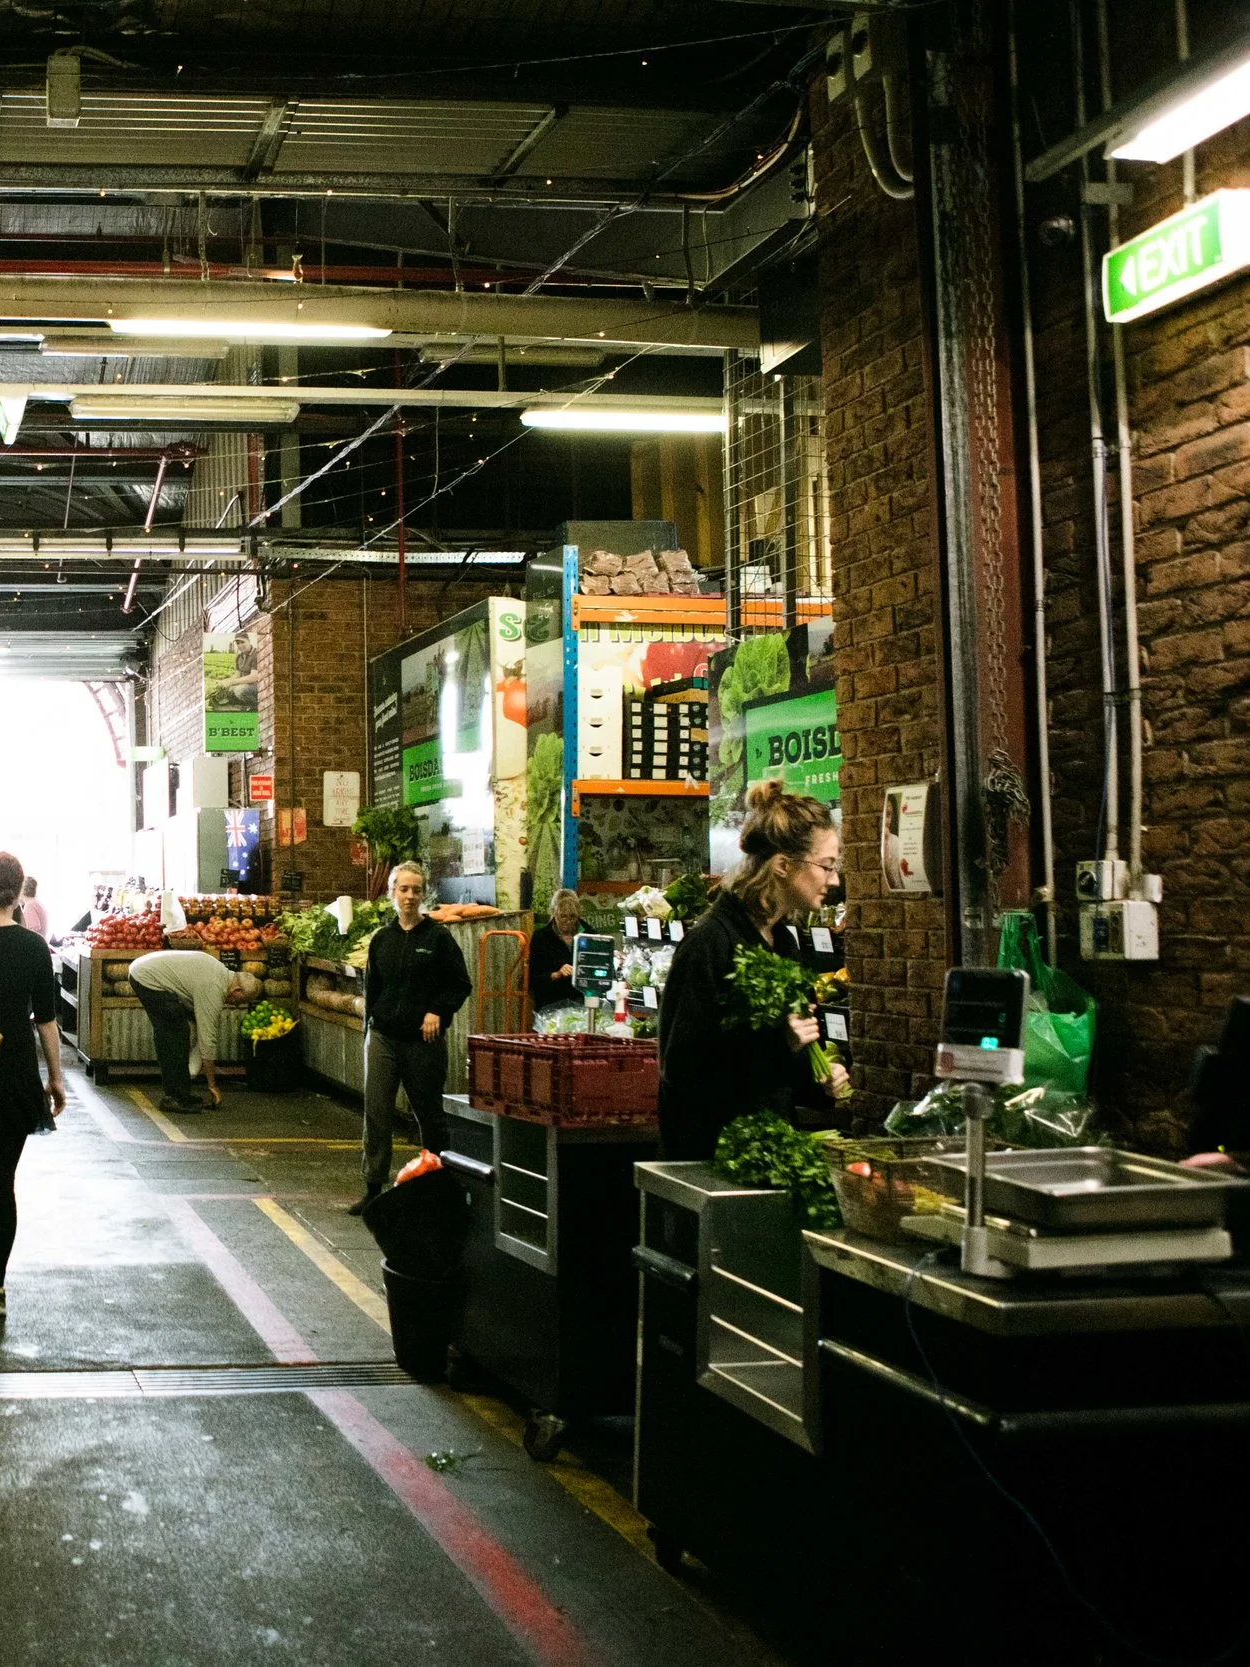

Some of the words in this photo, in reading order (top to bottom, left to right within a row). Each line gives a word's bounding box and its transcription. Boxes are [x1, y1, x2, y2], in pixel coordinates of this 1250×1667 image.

[1138, 214, 1208, 292] EXIT
[208, 727, 255, 737] B'BEST
[805, 771, 839, 786] FRESH
